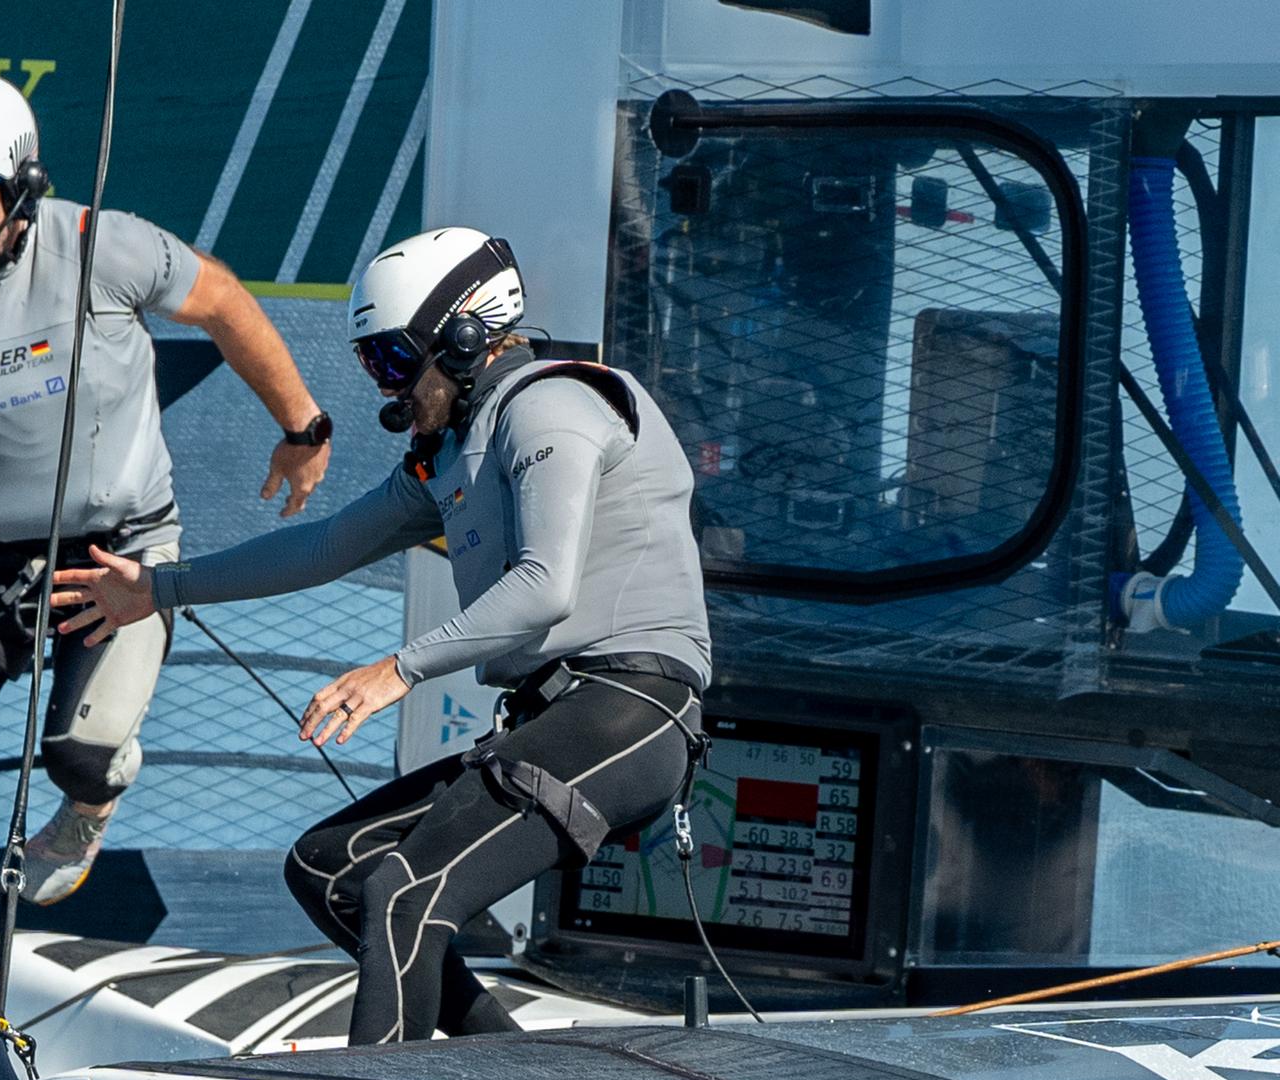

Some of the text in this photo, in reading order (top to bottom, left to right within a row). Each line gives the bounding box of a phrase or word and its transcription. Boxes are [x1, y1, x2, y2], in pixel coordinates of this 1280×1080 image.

[10, 390, 42, 407] Bank
[829, 788, 850, 806] 65
[780, 830, 814, 849] 38.3
[777, 857, 812, 876] 23.9
[821, 870, 847, 890] 6.9
[592, 892, 611, 909] 84
[778, 912, 804, 930] 7.5
